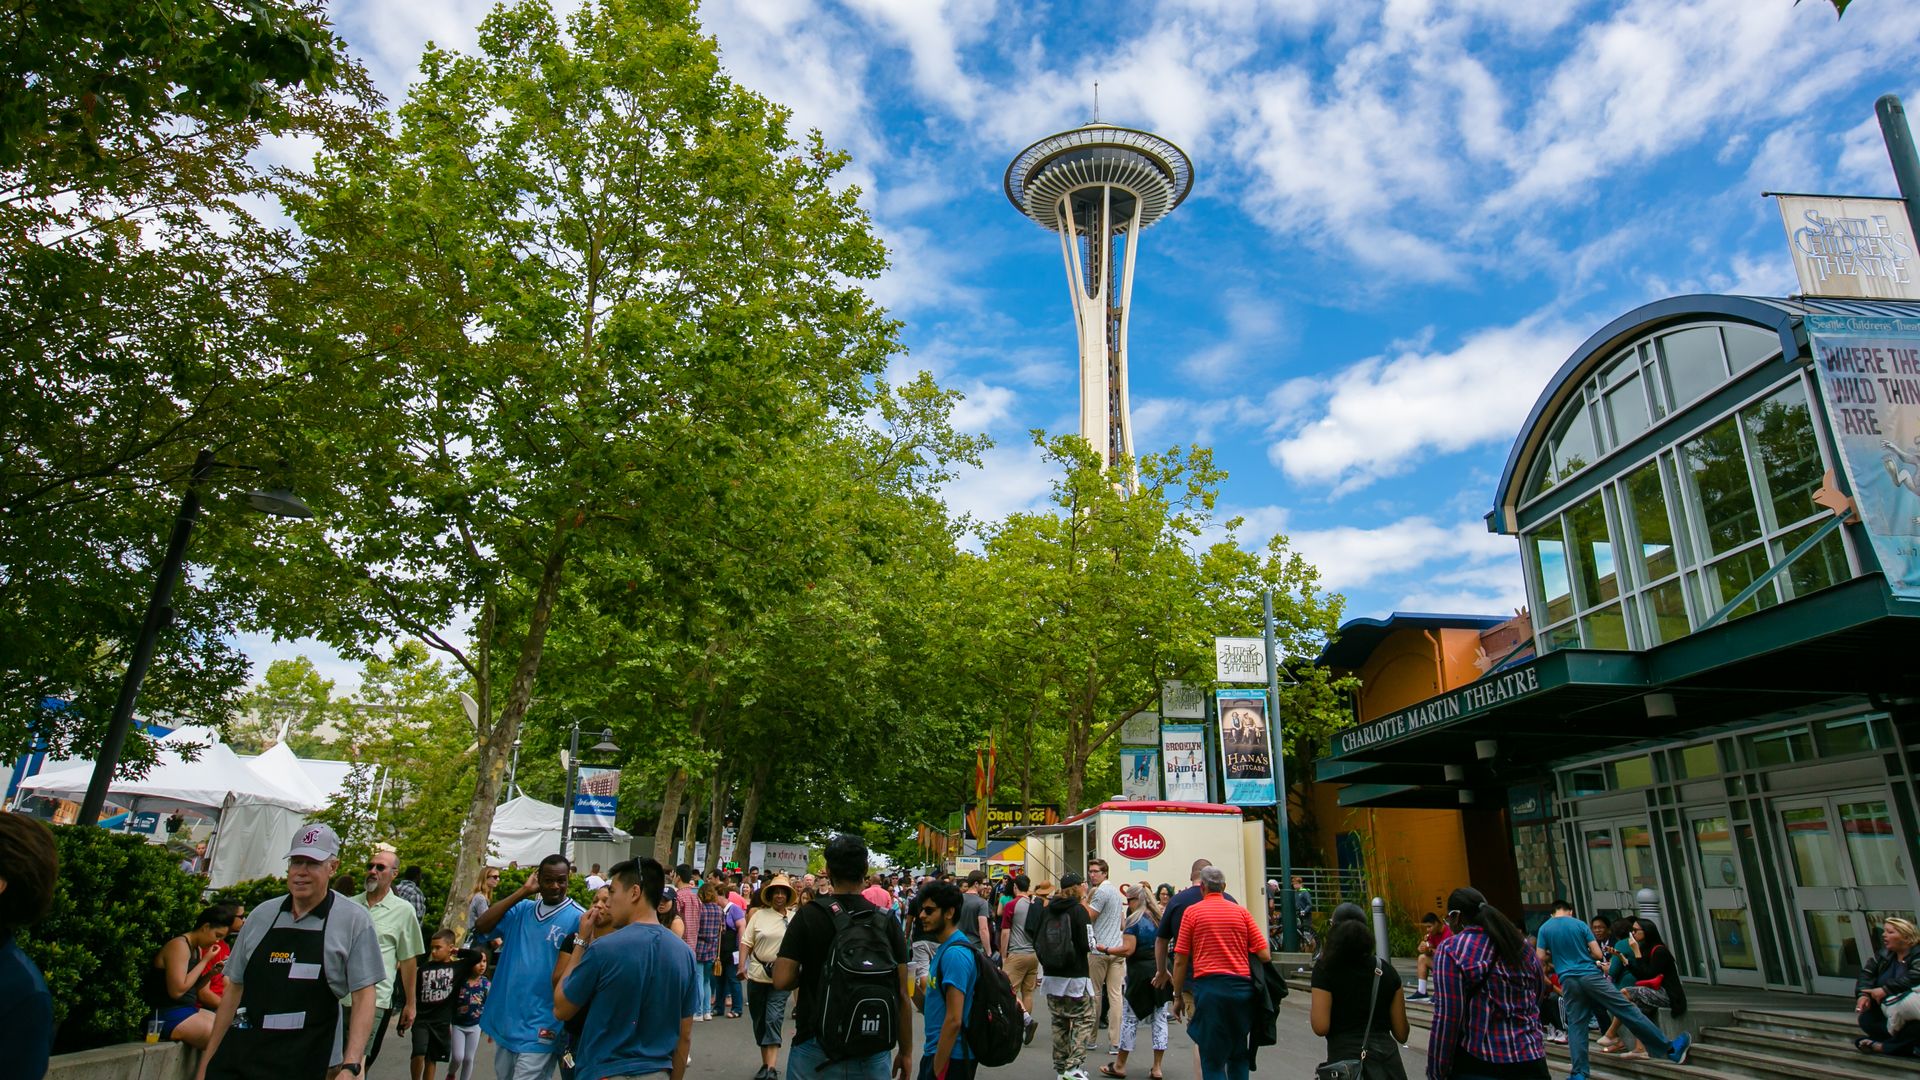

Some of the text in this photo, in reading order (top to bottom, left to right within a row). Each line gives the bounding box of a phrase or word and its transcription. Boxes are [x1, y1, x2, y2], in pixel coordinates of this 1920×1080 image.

[1803, 209, 1892, 237] SEATTLE
[1807, 255, 1910, 283] THEATRE
[1810, 317, 1845, 330] Seattle
[1821, 346, 1920, 374] WHERE THE
[1831, 377, 1920, 405] WILD THIN
[1840, 408, 1882, 435] ARE
[1341, 667, 1540, 752] CHARLOTTE MARTIN THEATRE
[1165, 742, 1202, 752] BROOKLYN
[1227, 752, 1269, 766] HANA'S
[1167, 762, 1204, 774] BRIDGE
[1231, 765, 1266, 773] SUITCASE
[988, 811, 1046, 822] ORN DGS
[1118, 834, 1161, 851] Fisher
[778, 849, 797, 861] xfinity
[726, 861, 739, 869] ATM
[862, 1014, 880, 1031] ini
